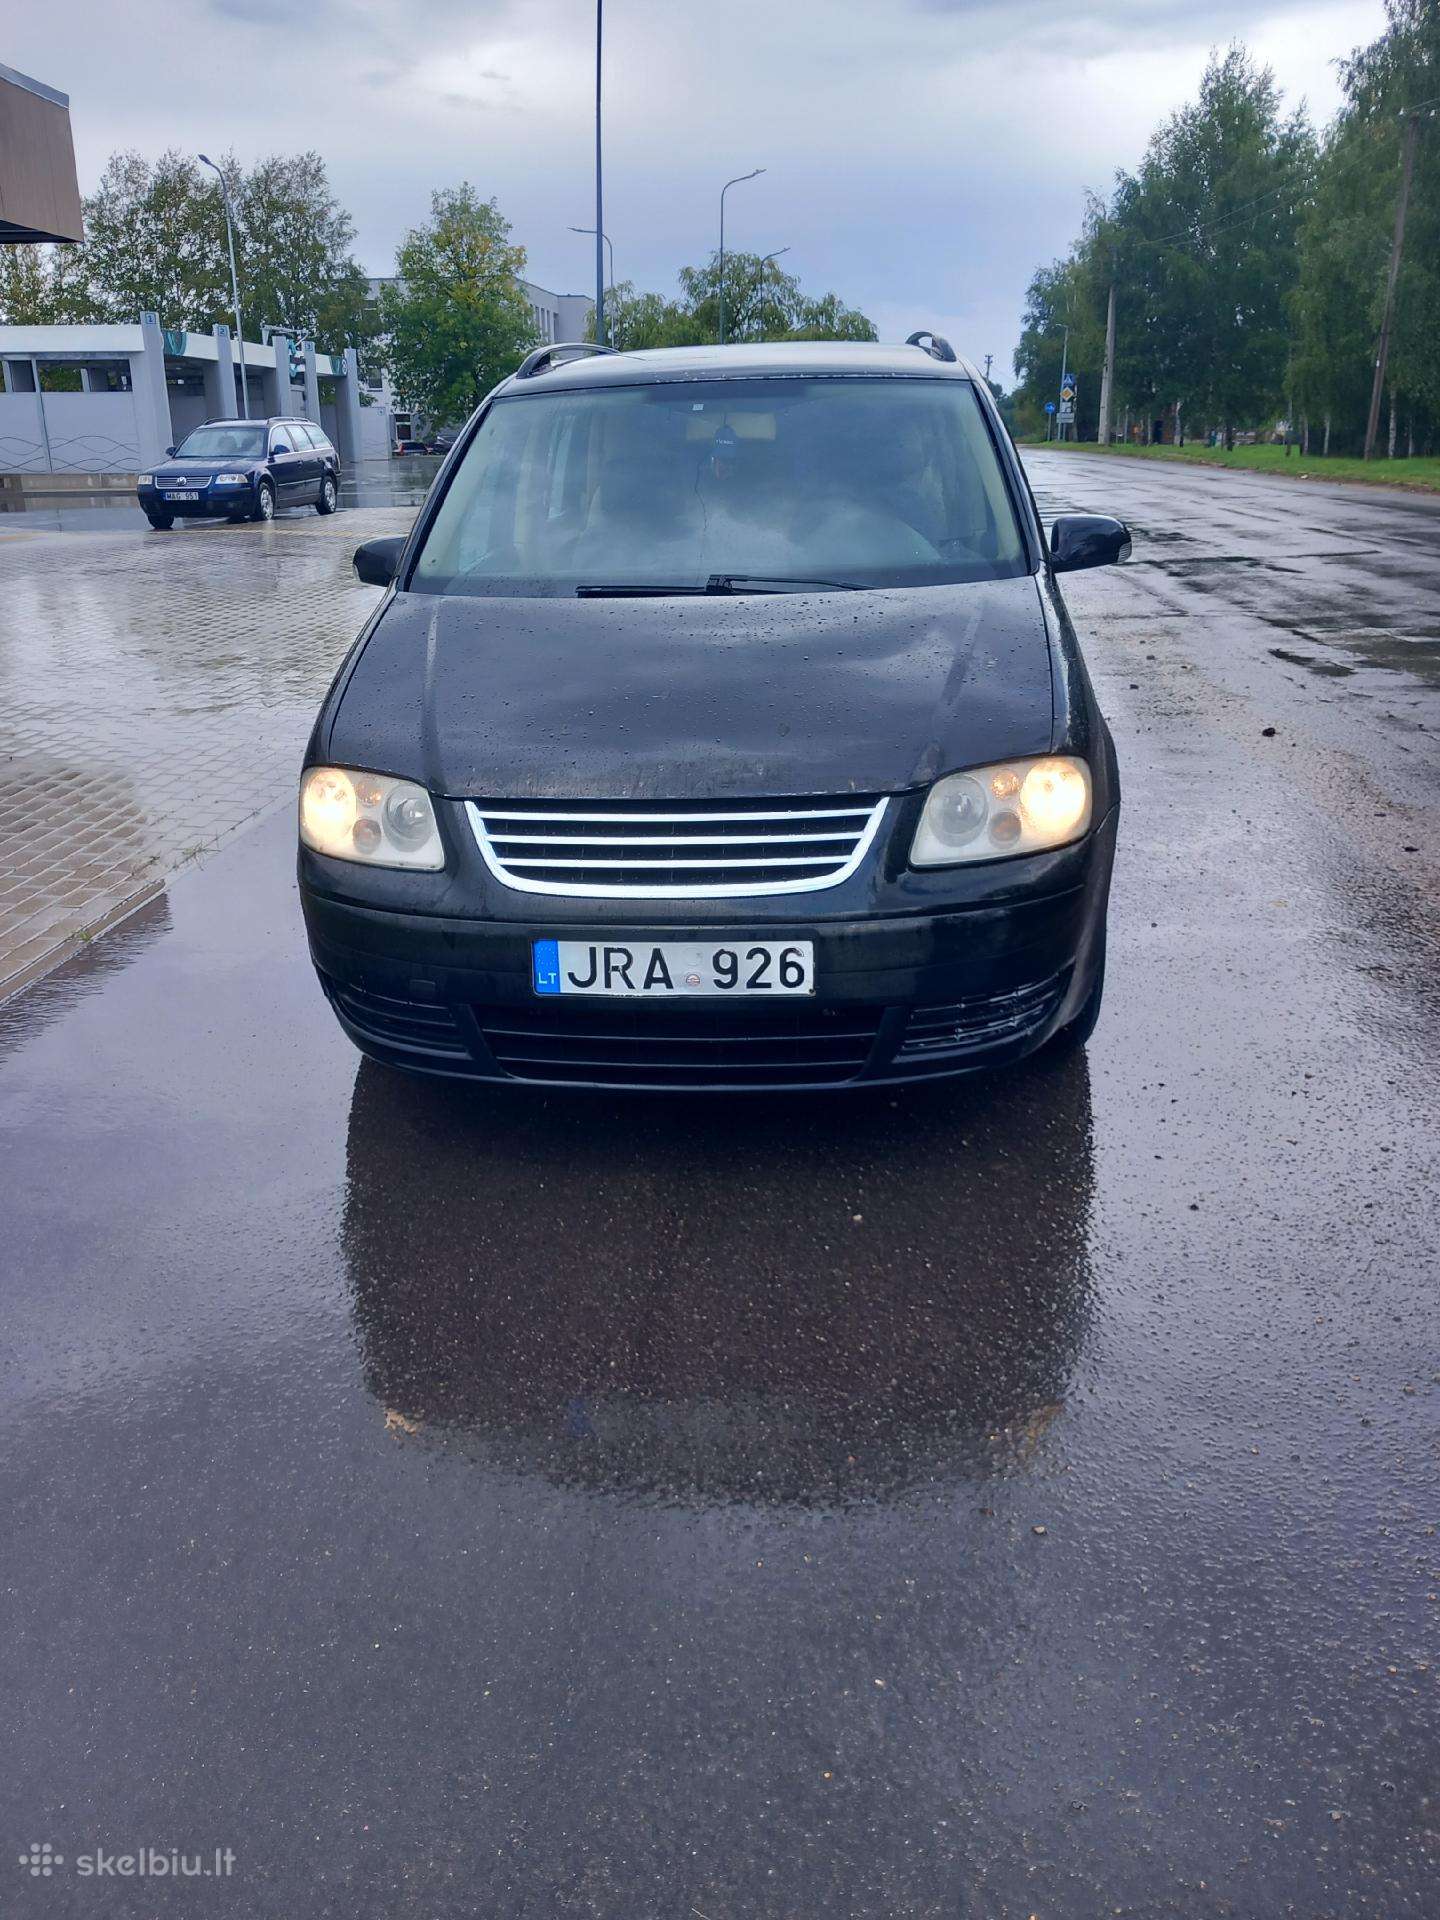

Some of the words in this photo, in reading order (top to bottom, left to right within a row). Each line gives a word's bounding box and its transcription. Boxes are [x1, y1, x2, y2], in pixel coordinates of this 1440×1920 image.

[538, 972, 557, 984] LT
[567, 947, 675, 990] JRA
[712, 947, 805, 990] 926
